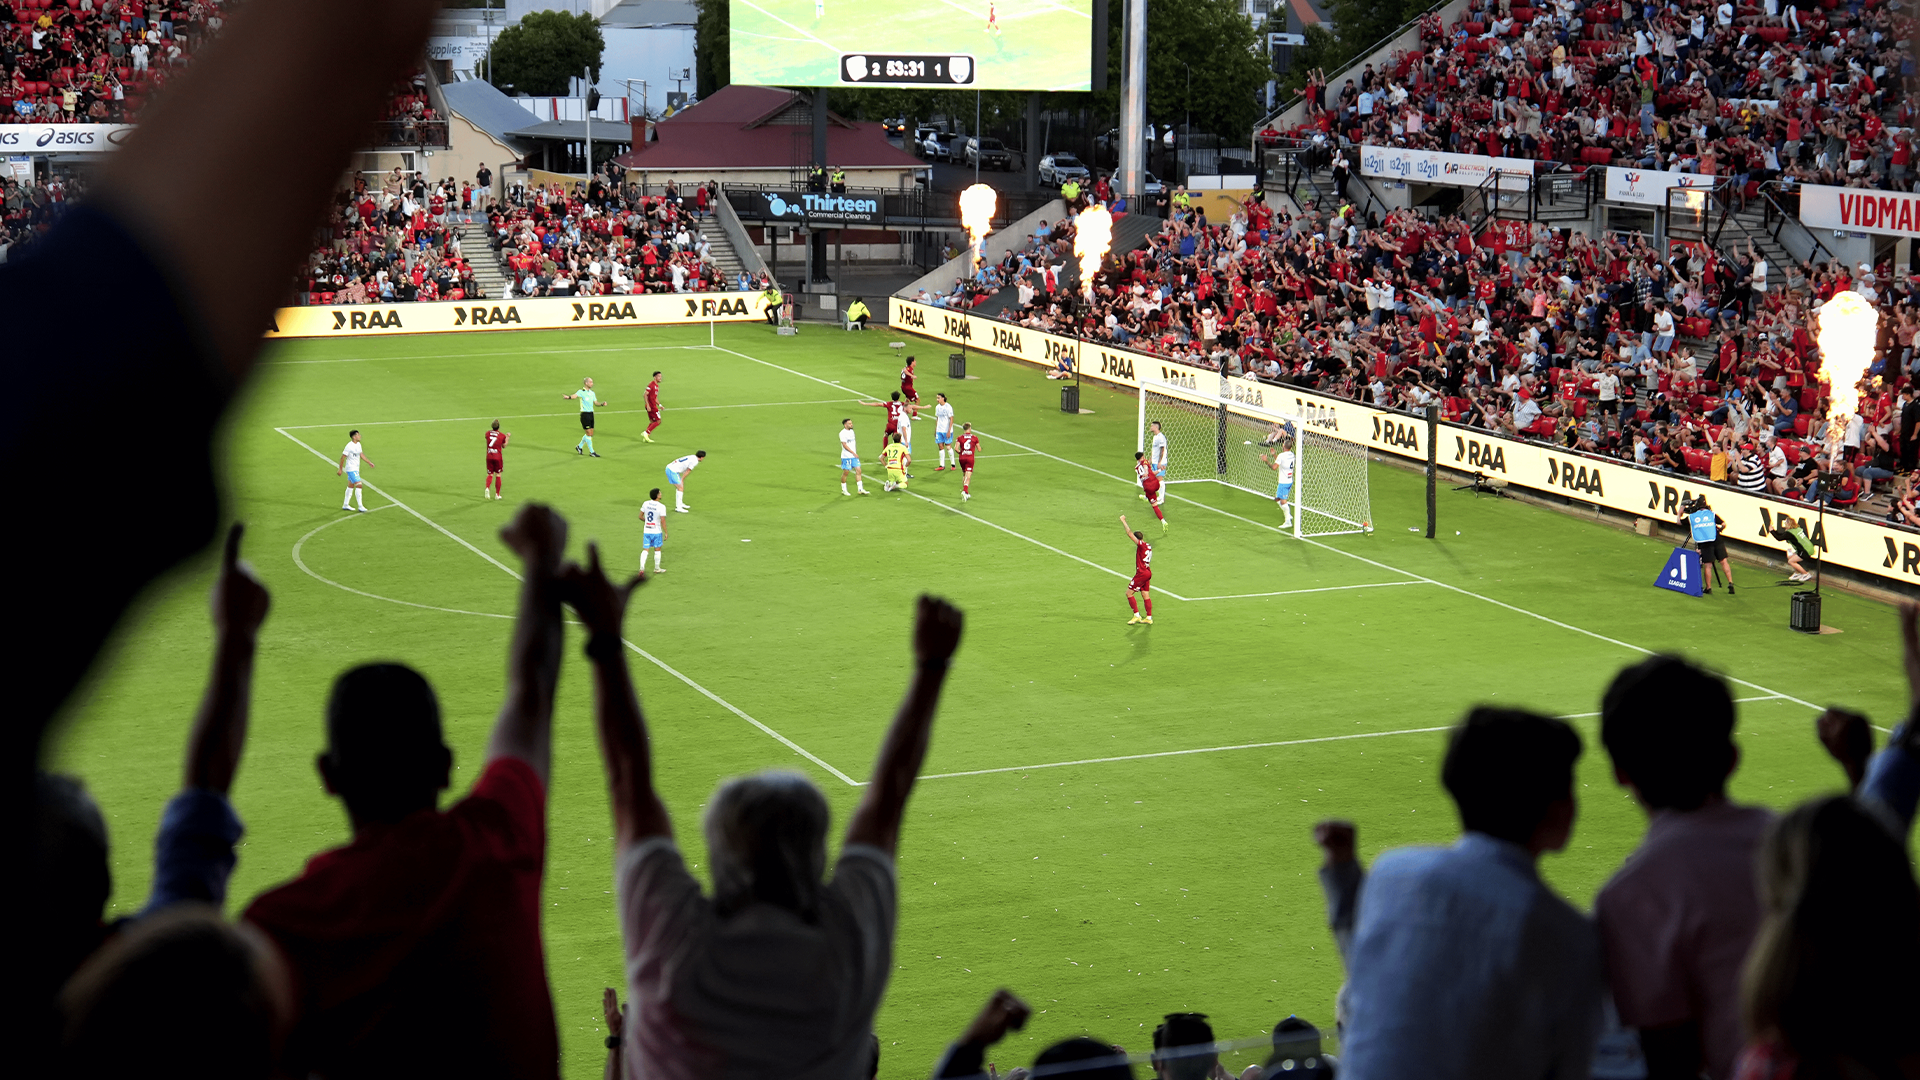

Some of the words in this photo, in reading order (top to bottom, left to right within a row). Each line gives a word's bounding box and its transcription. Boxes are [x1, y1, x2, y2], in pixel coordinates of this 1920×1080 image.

[871, 62, 881, 76] 2
[886, 60, 925, 77] 53:31
[934, 63, 941, 77] 1
[21, 105, 31, 113] 21
[802, 193, 877, 213] Thirteen
[808, 211, 844, 219] Commercial
[844, 212, 871, 220] Cleaning
[472, 306, 522, 325] RAA
[589, 302, 637, 321] RAA
[702, 298, 749, 316] RAA
[351, 310, 402, 329] RAA
[905, 308, 925, 328] RAA
[951, 319, 972, 340] RAA
[1000, 329, 1022, 353] RAA
[1109, 355, 1135, 381] RAA
[1568, 387, 1573, 396] 2
[489, 436, 497, 447] 7
[963, 439, 972, 450] 6
[1384, 422, 1419, 451] RAA
[1468, 441, 1507, 474] RAA
[1562, 463, 1604, 497] RAA
[647, 511, 654, 523] 8
